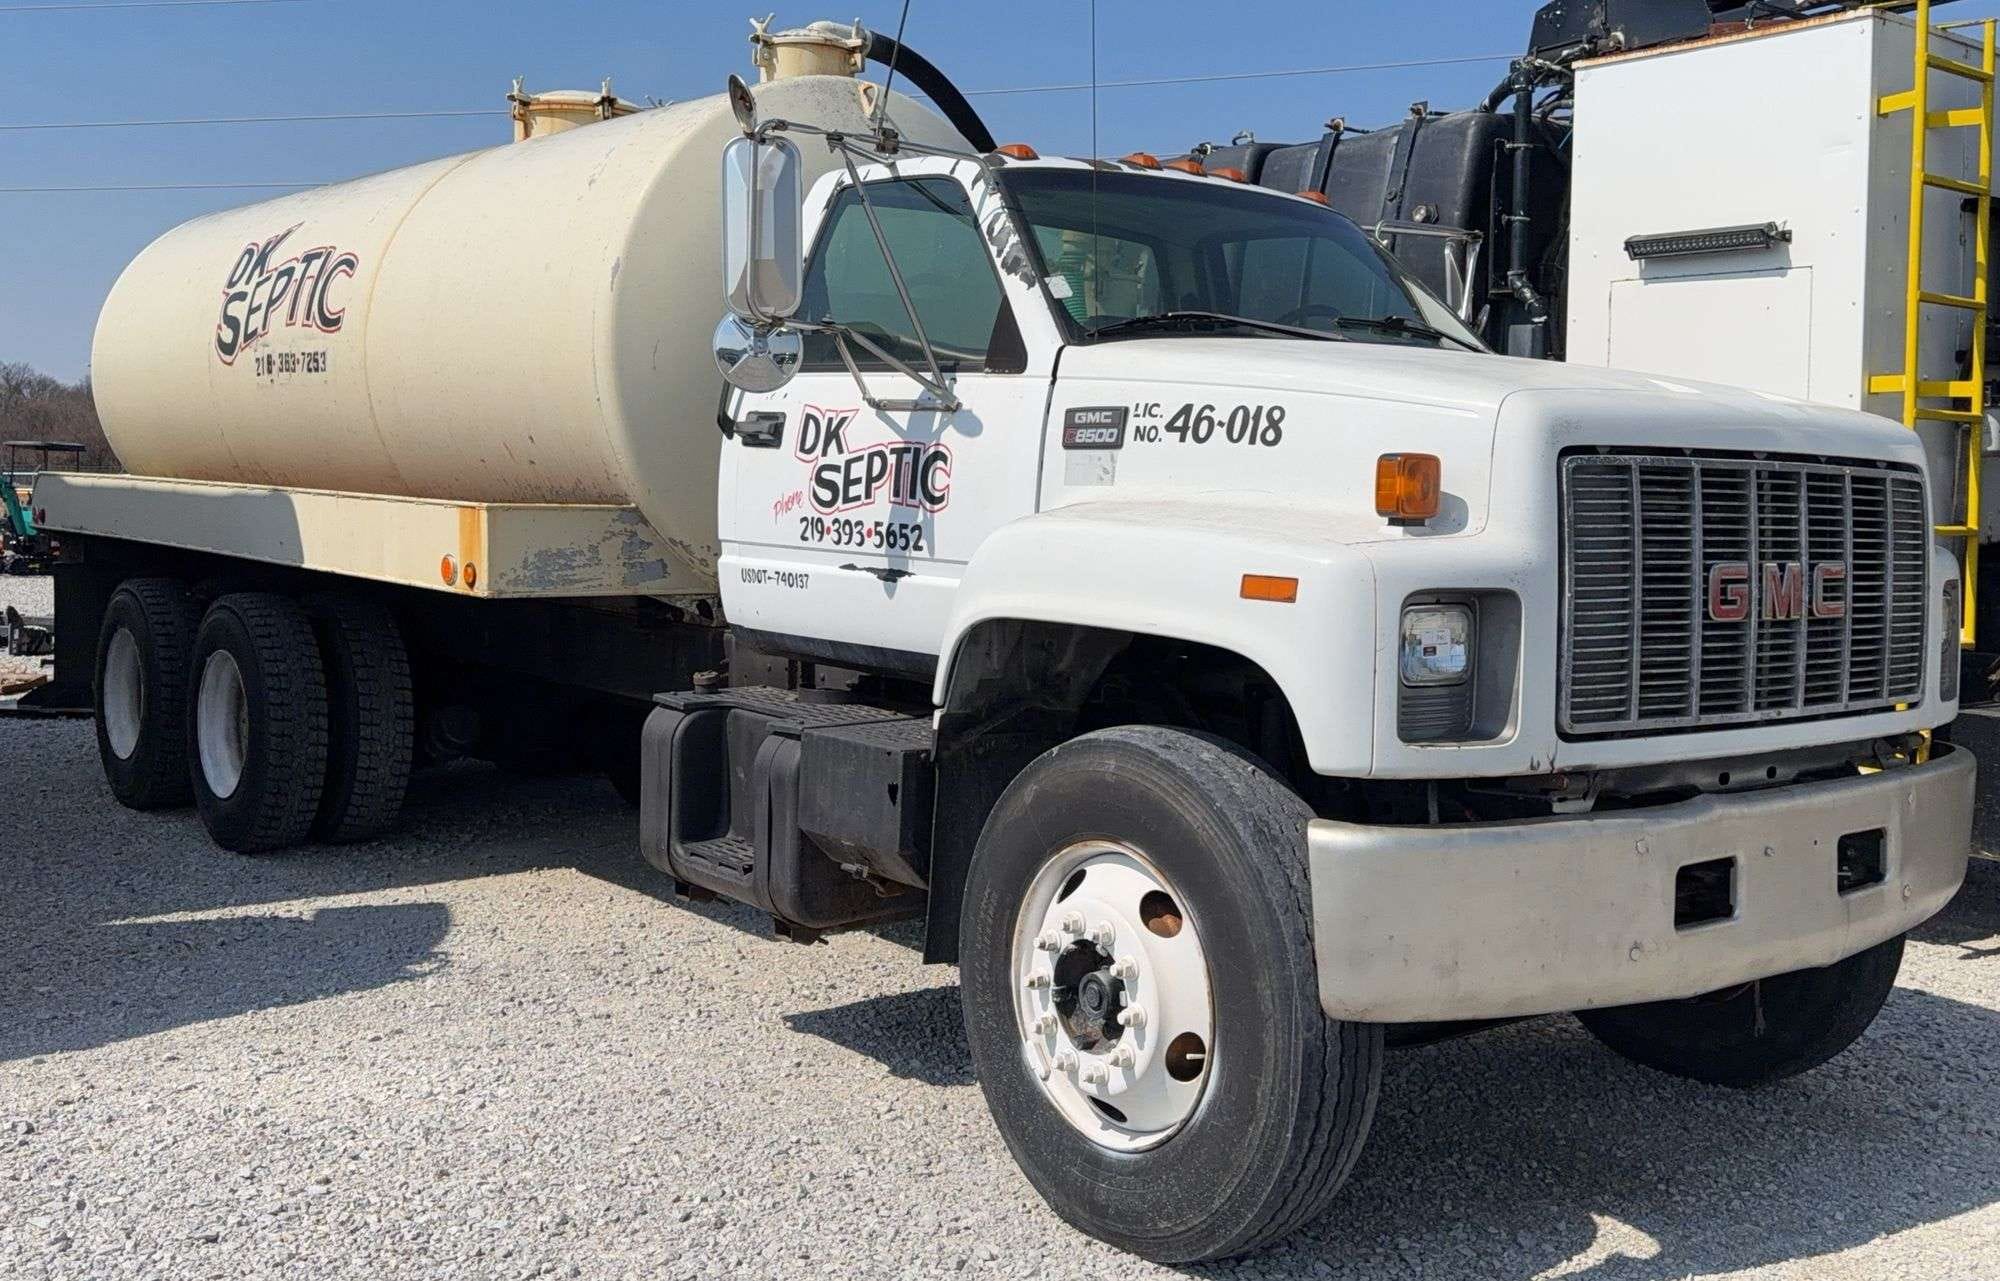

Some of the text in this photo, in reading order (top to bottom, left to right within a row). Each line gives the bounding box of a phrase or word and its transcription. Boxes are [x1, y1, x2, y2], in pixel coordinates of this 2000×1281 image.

[225, 229, 298, 290] DK
[216, 249, 357, 358] SEPTIC
[1074, 411, 1113, 424] GMC
[1133, 402, 1164, 418] LIC.
[798, 410, 852, 459] DK
[1133, 425, 1163, 443] NO.
[811, 444, 950, 510] SEPTIC
[773, 489, 804, 524] phone
[740, 567, 810, 590] USDOT-740137
[1708, 562, 1846, 622] GMC
